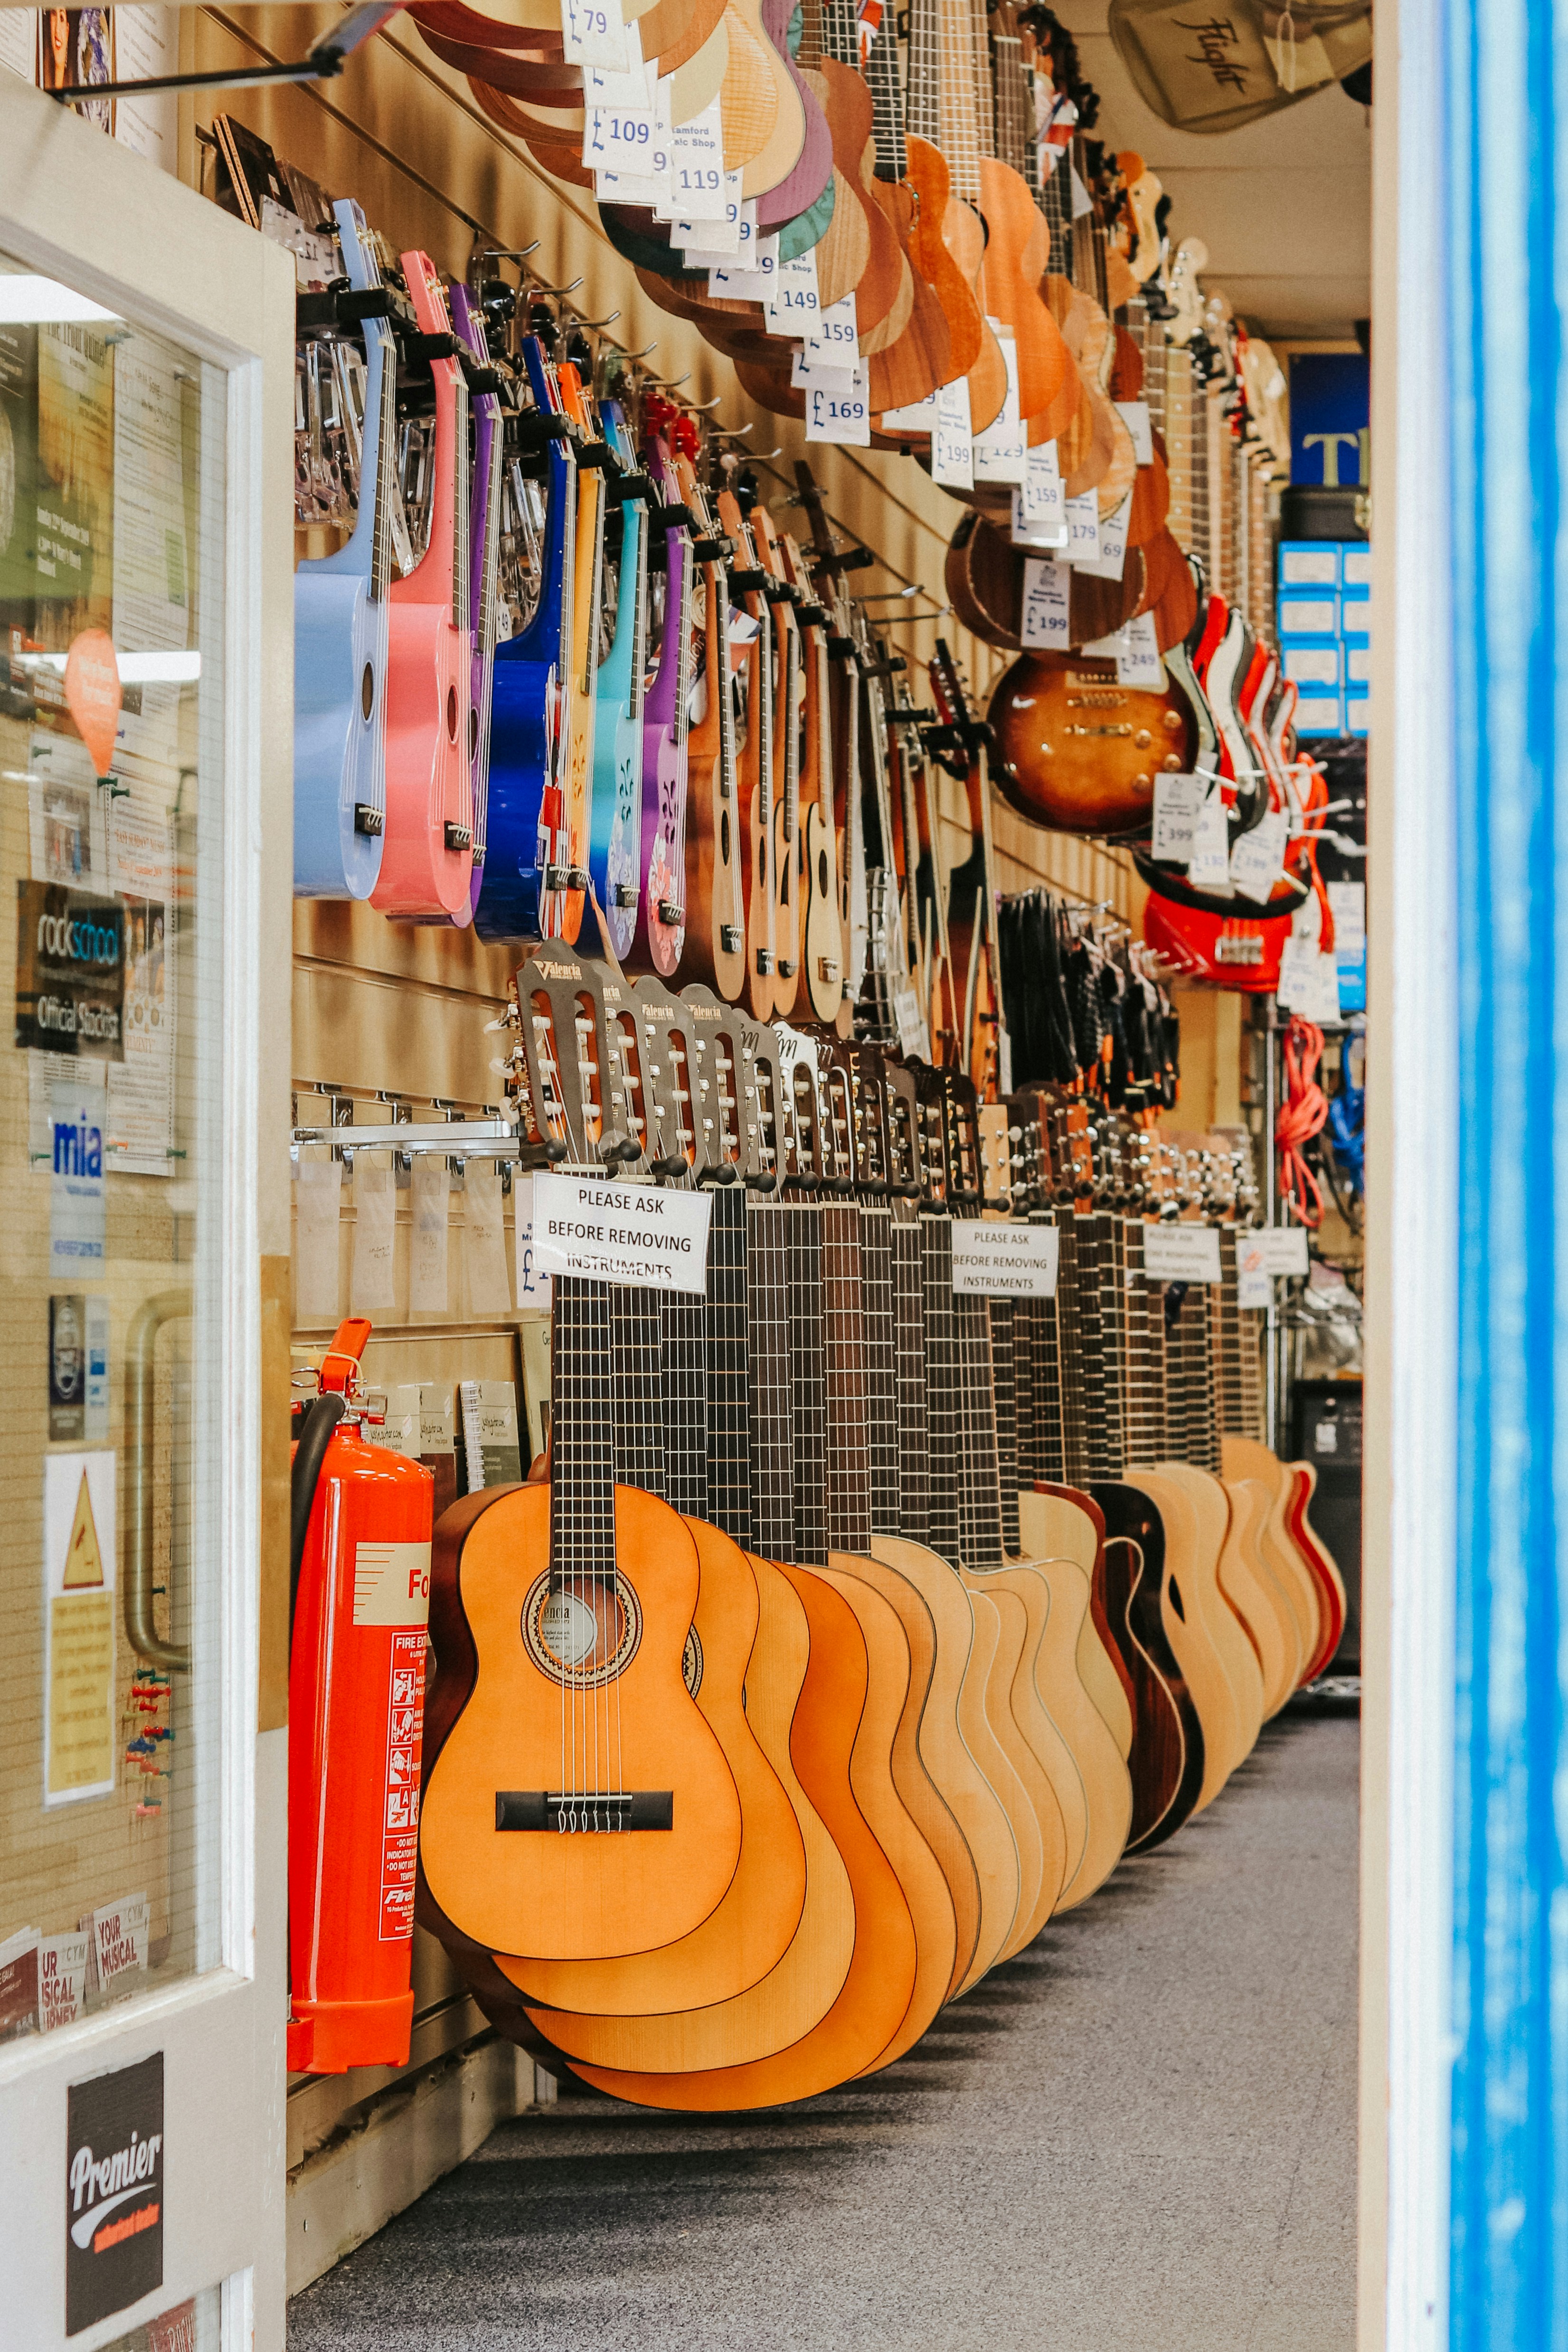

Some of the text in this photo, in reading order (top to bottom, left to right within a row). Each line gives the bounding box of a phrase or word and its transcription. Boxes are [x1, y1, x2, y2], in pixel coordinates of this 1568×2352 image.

[584, 9, 607, 33] 79
[1171, 17, 1249, 94] Flight
[610, 118, 649, 143] 109
[692, 139, 716, 149] Shop
[679, 170, 720, 189] 119
[792, 264, 812, 273] Shop
[784, 291, 817, 309] 149
[823, 323, 854, 342] 159
[829, 402, 864, 418] 169
[947, 445, 970, 463] 199
[1037, 488, 1057, 503] 159
[1072, 525, 1096, 539] 179
[1040, 617, 1067, 631] 199
[532, 960, 582, 981] Valencia
[54, 1108, 102, 1178] mia
[579, 1190, 664, 1214] PLEASE ASK
[549, 1220, 604, 1241] BEFORE
[609, 1231, 691, 1253] REMOVING
[974, 1232, 1030, 1245] PLEASE ASK
[567, 1253, 672, 1279] INSTRUMENTS
[953, 1255, 1047, 1269] BEFORE REMOVING
[963, 1276, 1033, 1289] INSTRUMENTS
[396, 1637, 416, 1649] FIRE
[402, 1790, 409, 1805] A
[387, 1849, 412, 1860] INDICATOR
[398, 1861, 407, 1870] NOT
[98, 1914, 121, 1948] YOUR
[42, 1951, 57, 1979] UR
[101, 1936, 137, 1977] MUSICAL
[70, 2131, 163, 2212] Premier
